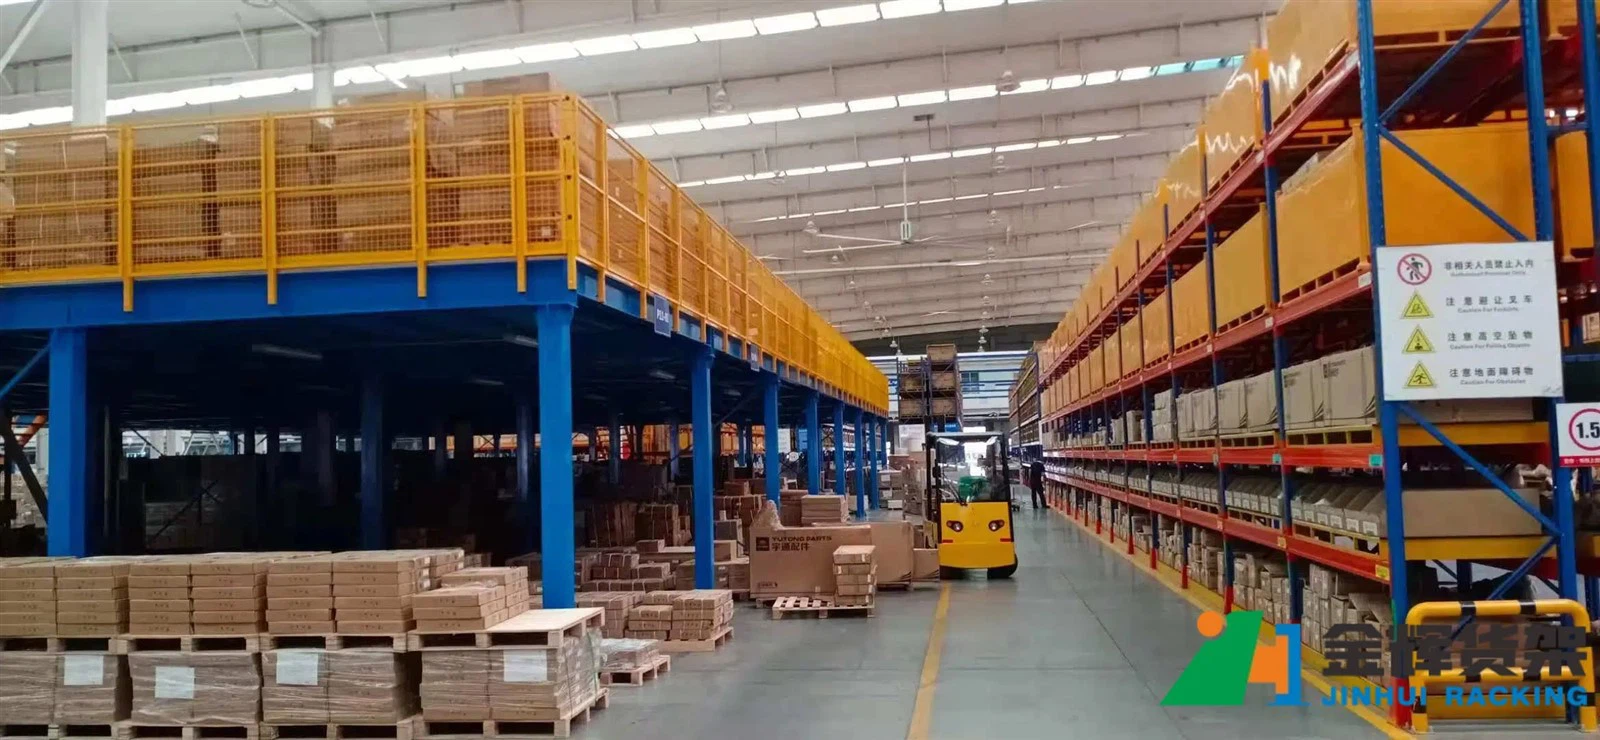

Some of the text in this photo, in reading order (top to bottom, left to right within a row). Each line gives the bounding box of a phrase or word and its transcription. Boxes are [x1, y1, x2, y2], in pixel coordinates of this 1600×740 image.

[1446, 295, 1532, 306] 注意避让叉车
[1448, 331, 1532, 341] 注意高空坠物
[1450, 367, 1533, 377] 注意地面障碍物
[771, 542, 810, 551] 宇通配件
